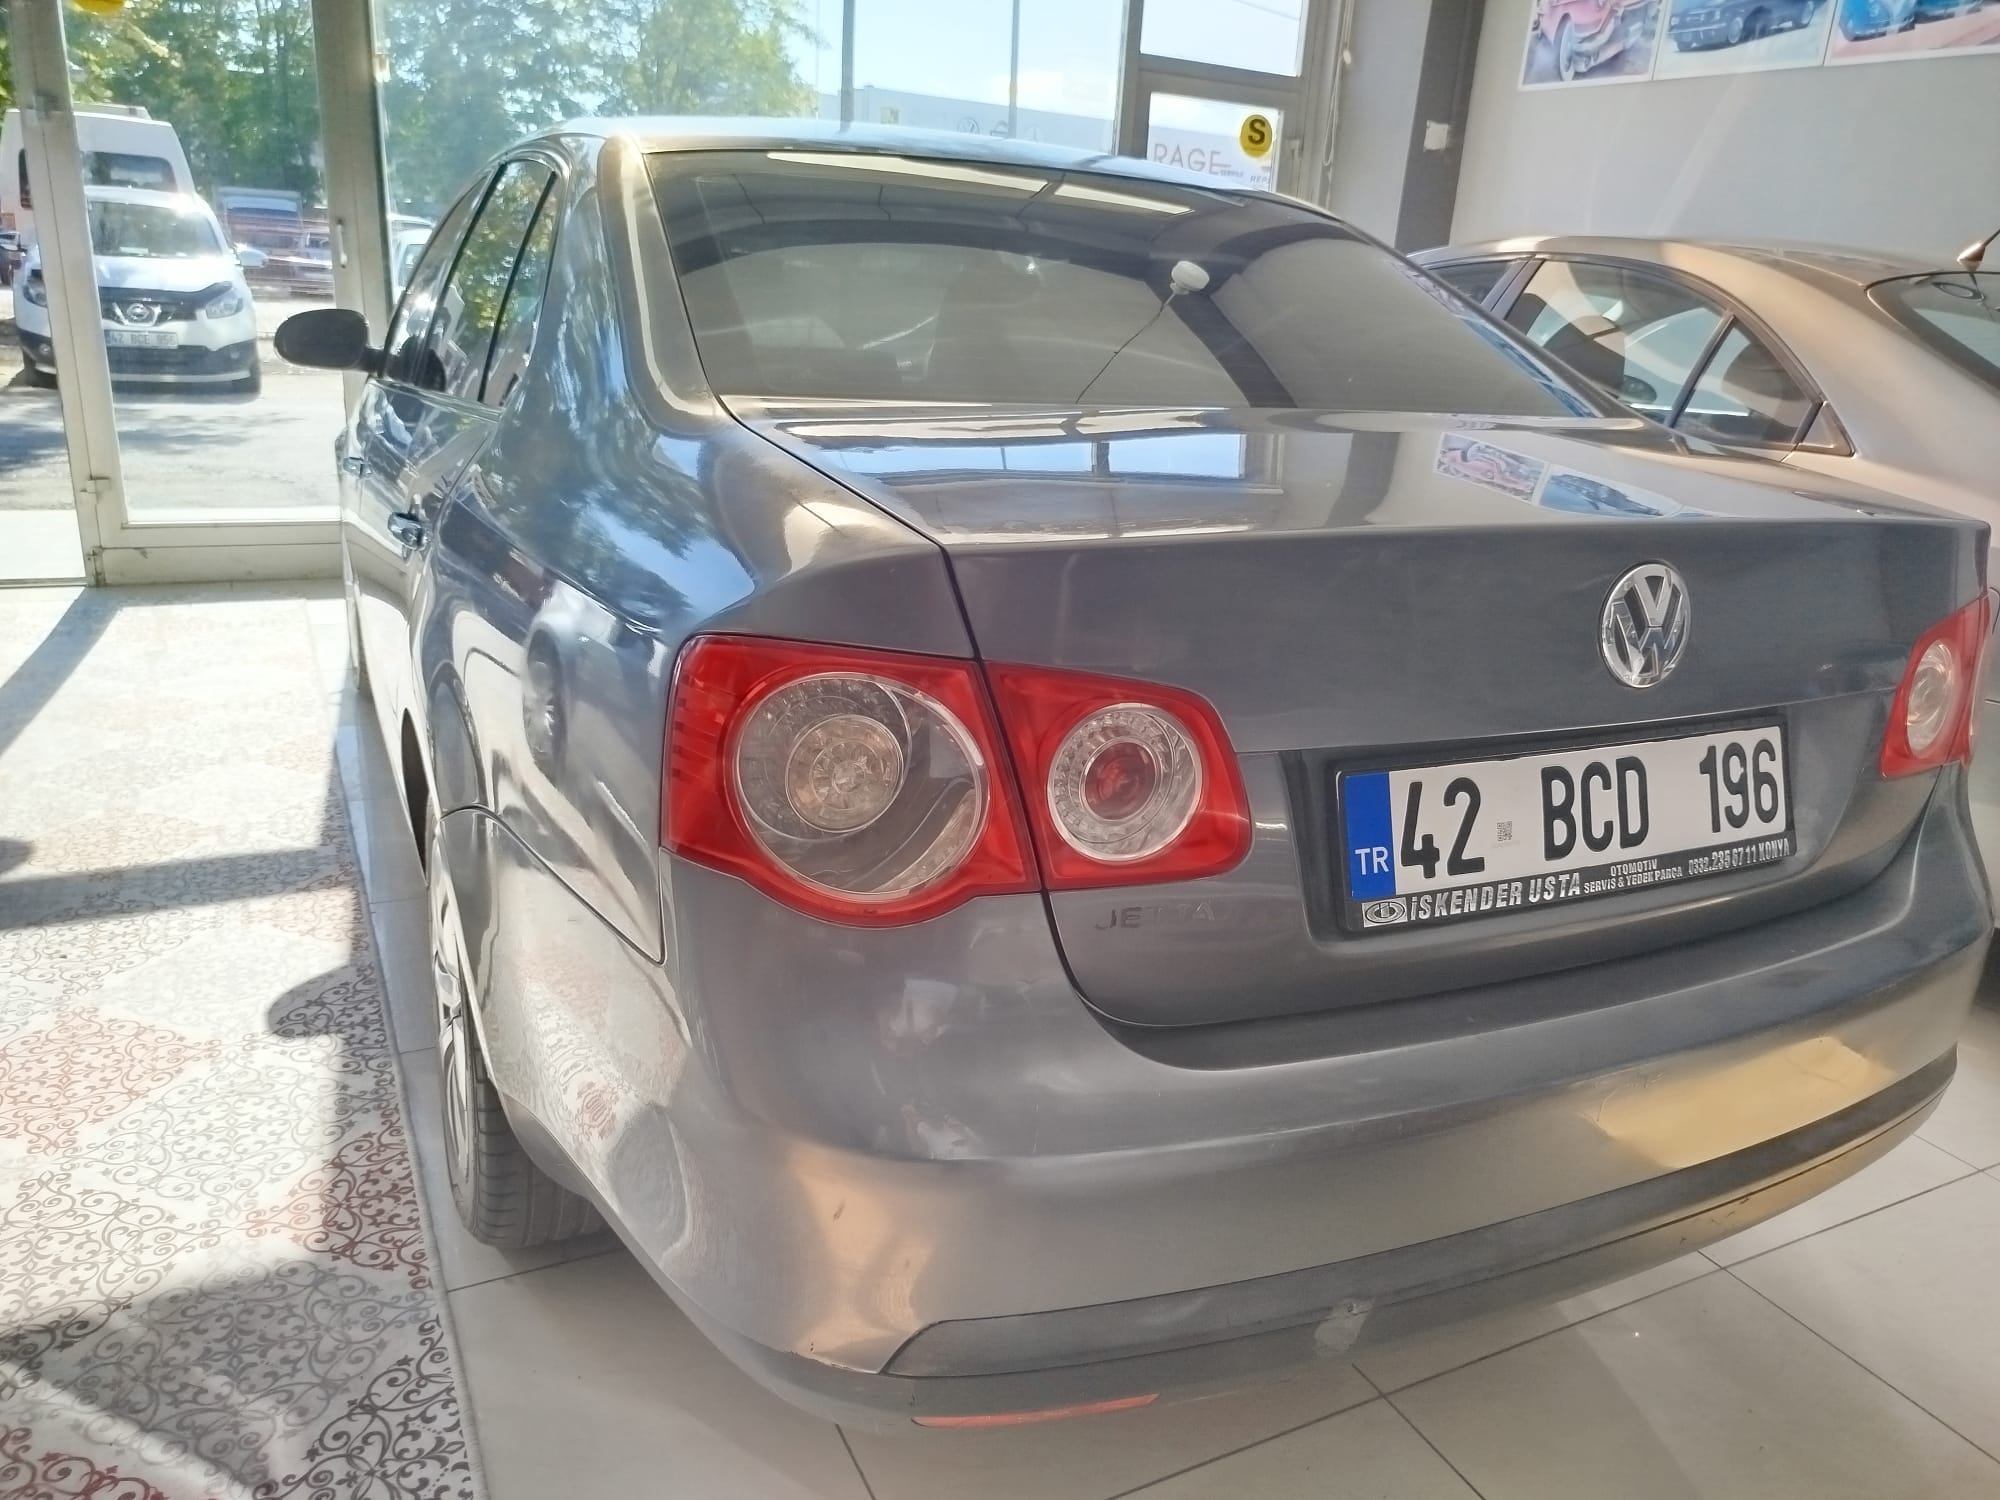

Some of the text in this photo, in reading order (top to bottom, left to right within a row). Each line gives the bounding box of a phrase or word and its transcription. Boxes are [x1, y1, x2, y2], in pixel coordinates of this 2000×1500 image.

[1355, 738, 1779, 880] TR 42 BCD 196
[1758, 838, 1790, 862] KONYA
[1529, 872, 1581, 903] USTA
